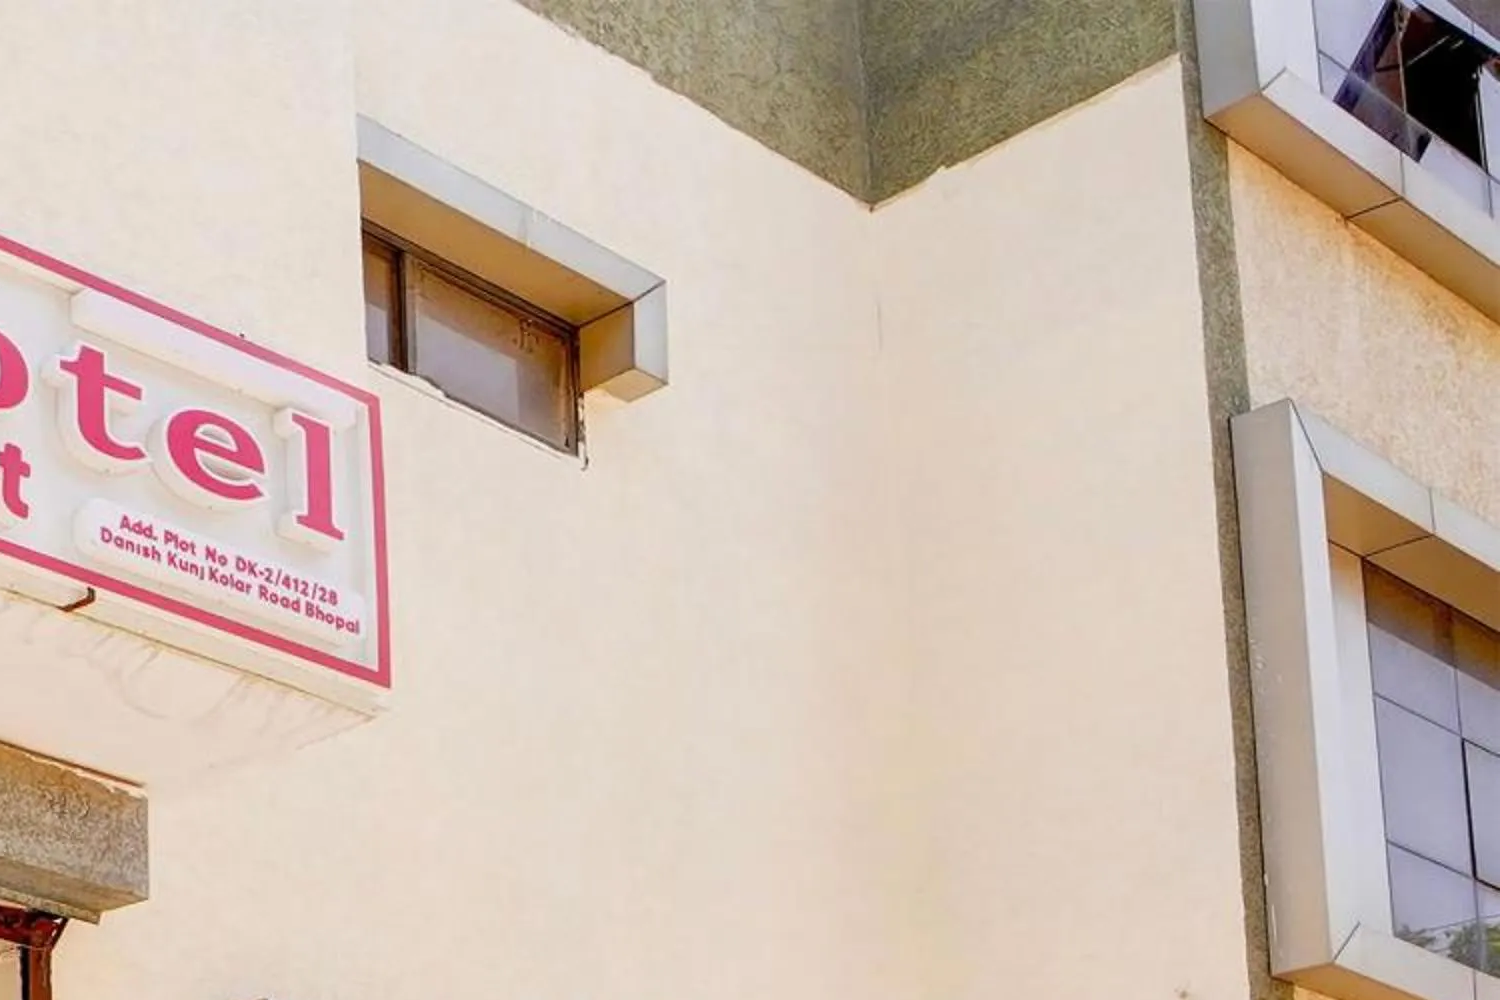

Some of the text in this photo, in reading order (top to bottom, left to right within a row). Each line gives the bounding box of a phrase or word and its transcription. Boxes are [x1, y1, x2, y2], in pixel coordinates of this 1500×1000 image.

[120, 515, 157, 541] Add.
[164, 530, 196, 555] Plot
[205, 546, 228, 566] No
[100, 527, 161, 562] Danish
[209, 567, 252, 594] Kolar
[259, 585, 300, 613] Road
[305, 601, 360, 634] Bhopal
